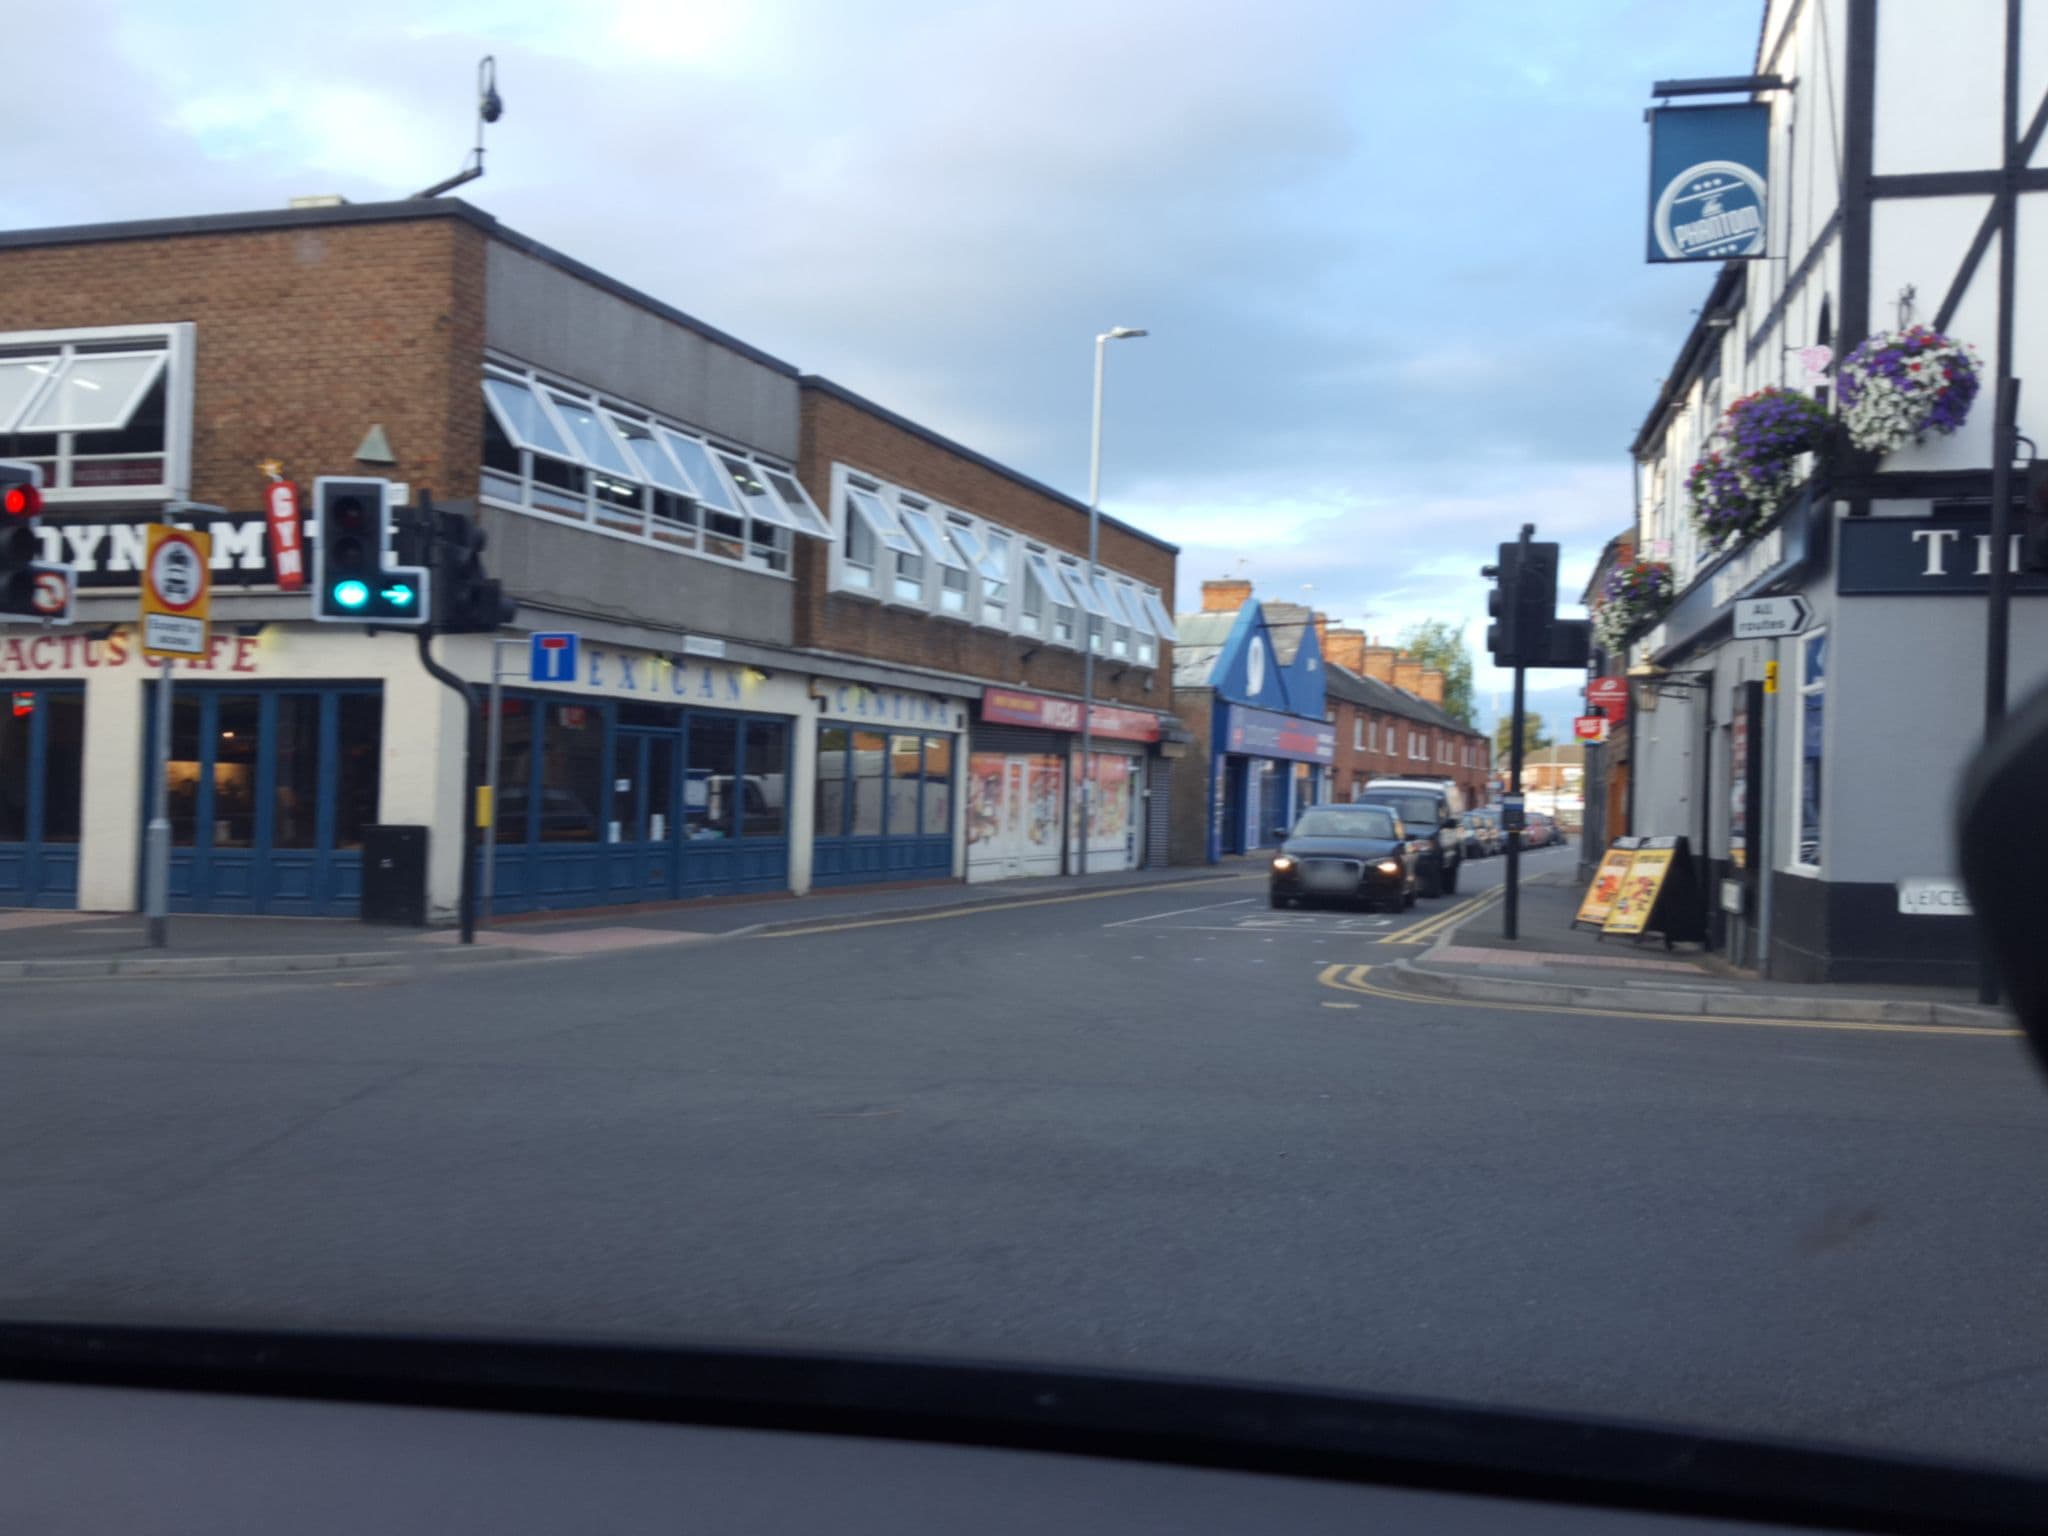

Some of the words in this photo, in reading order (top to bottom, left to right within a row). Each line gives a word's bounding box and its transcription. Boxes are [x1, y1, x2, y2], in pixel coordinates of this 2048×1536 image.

[32, 520, 267, 571] DYNM
[1739, 620, 1786, 633] routes
[145, 634, 260, 672] FE
[1904, 889, 1971, 906] LEICE
